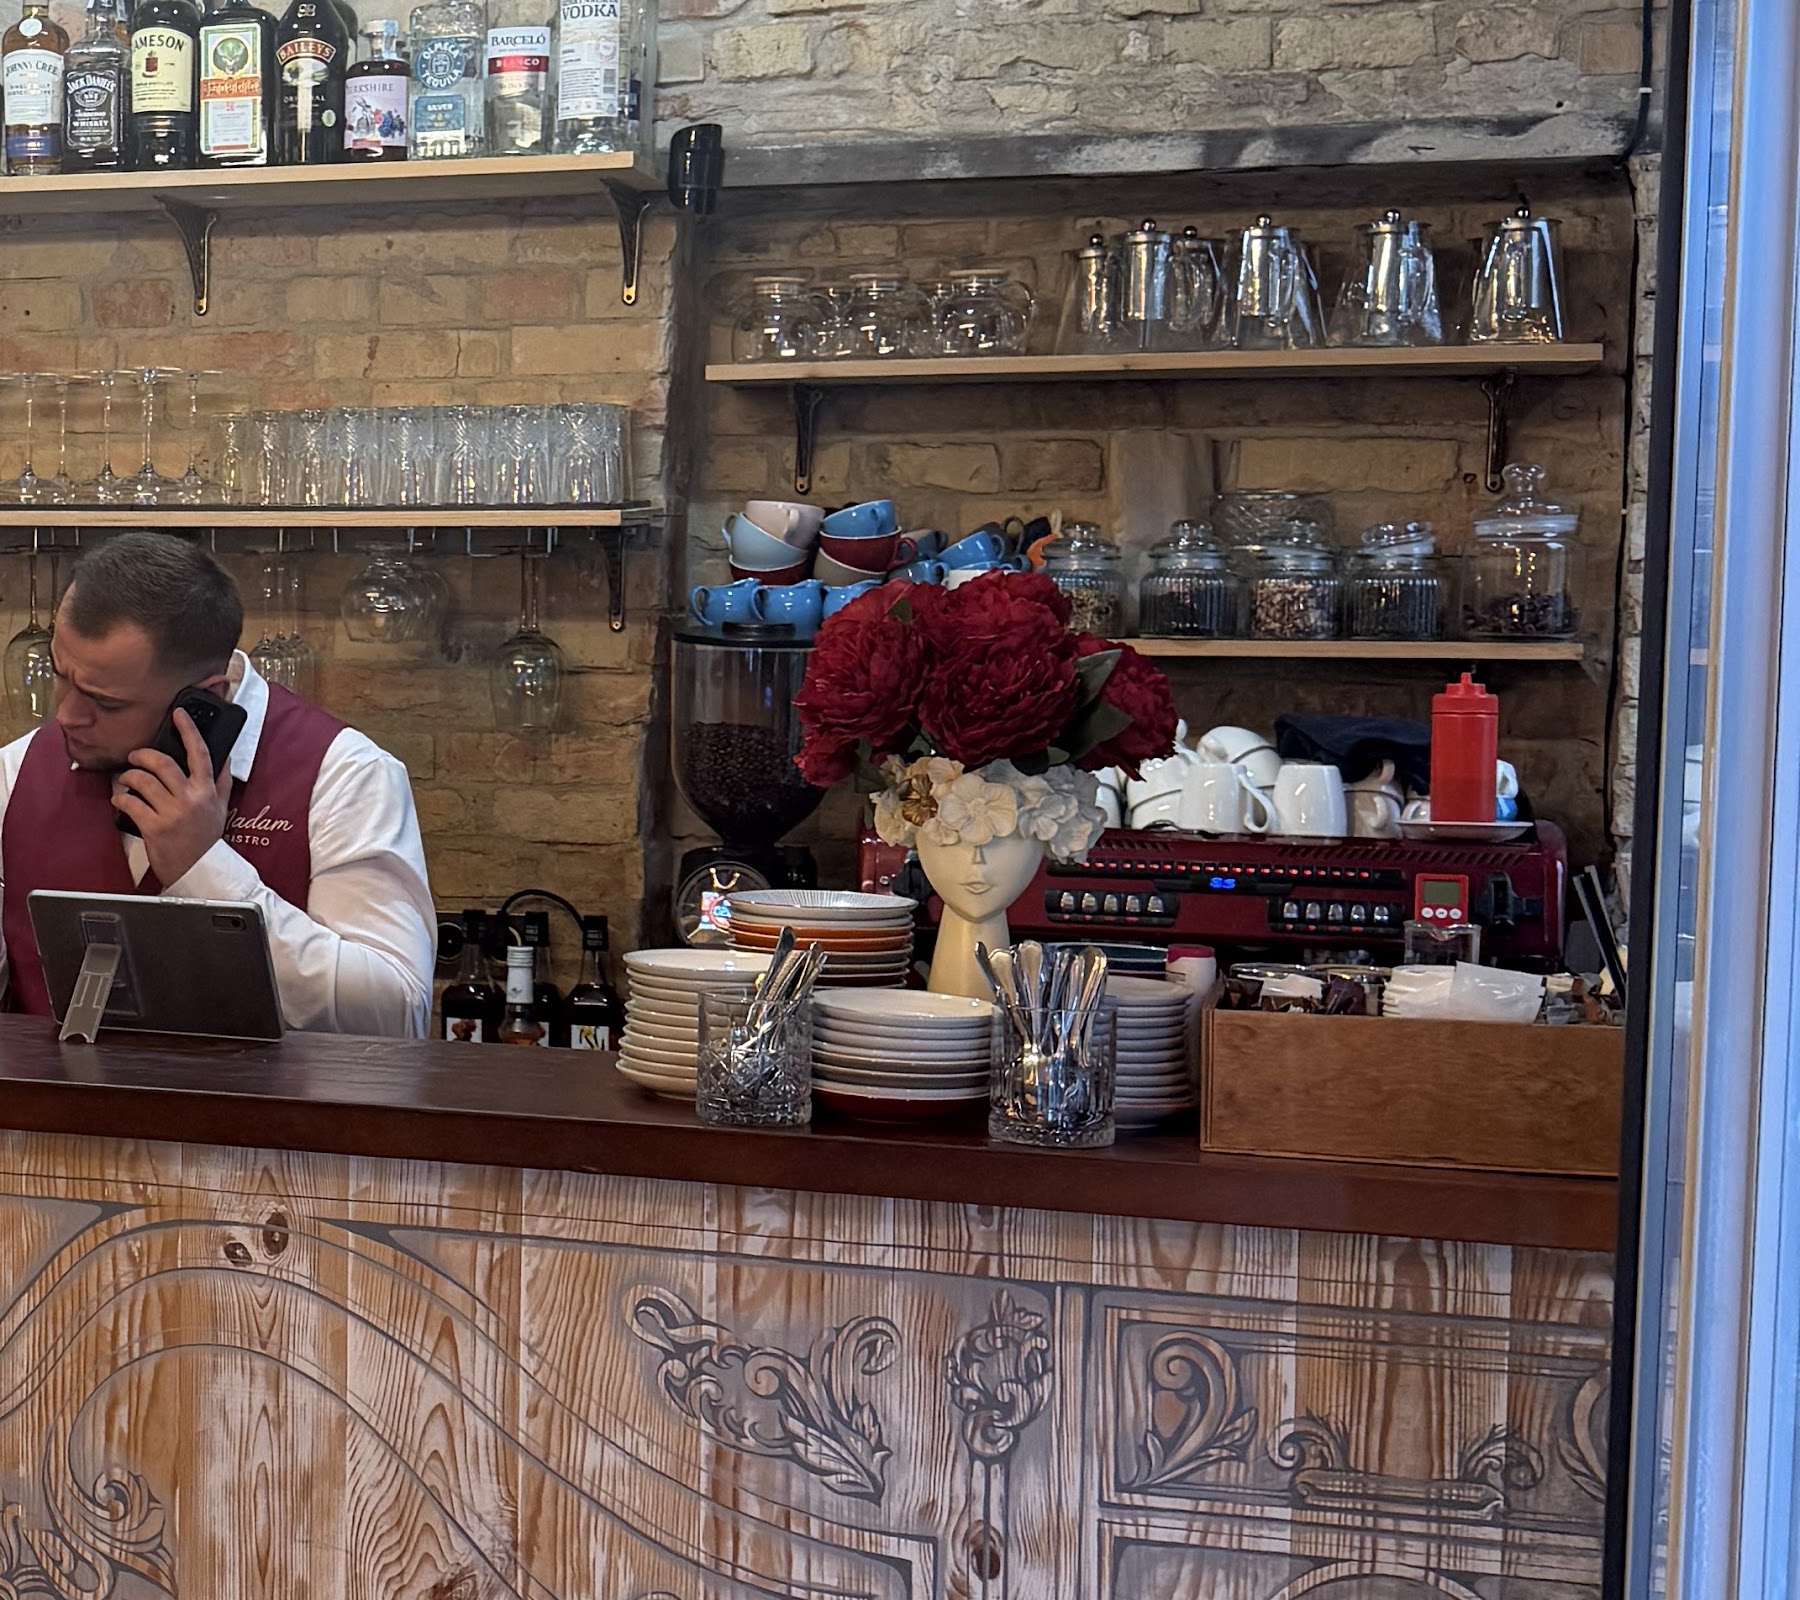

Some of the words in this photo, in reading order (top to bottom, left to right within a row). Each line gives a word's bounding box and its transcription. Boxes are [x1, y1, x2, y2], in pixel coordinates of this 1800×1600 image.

[562, 4, 619, 20] VODKA
[133, 34, 186, 53] AMESON
[279, 39, 332, 59] BAILEYS
[491, 33, 546, 47] BARCELÓ
[422, 41, 460, 60] OLMECA
[66, 76, 87, 94] JACK
[421, 69, 461, 89] TEQUILA
